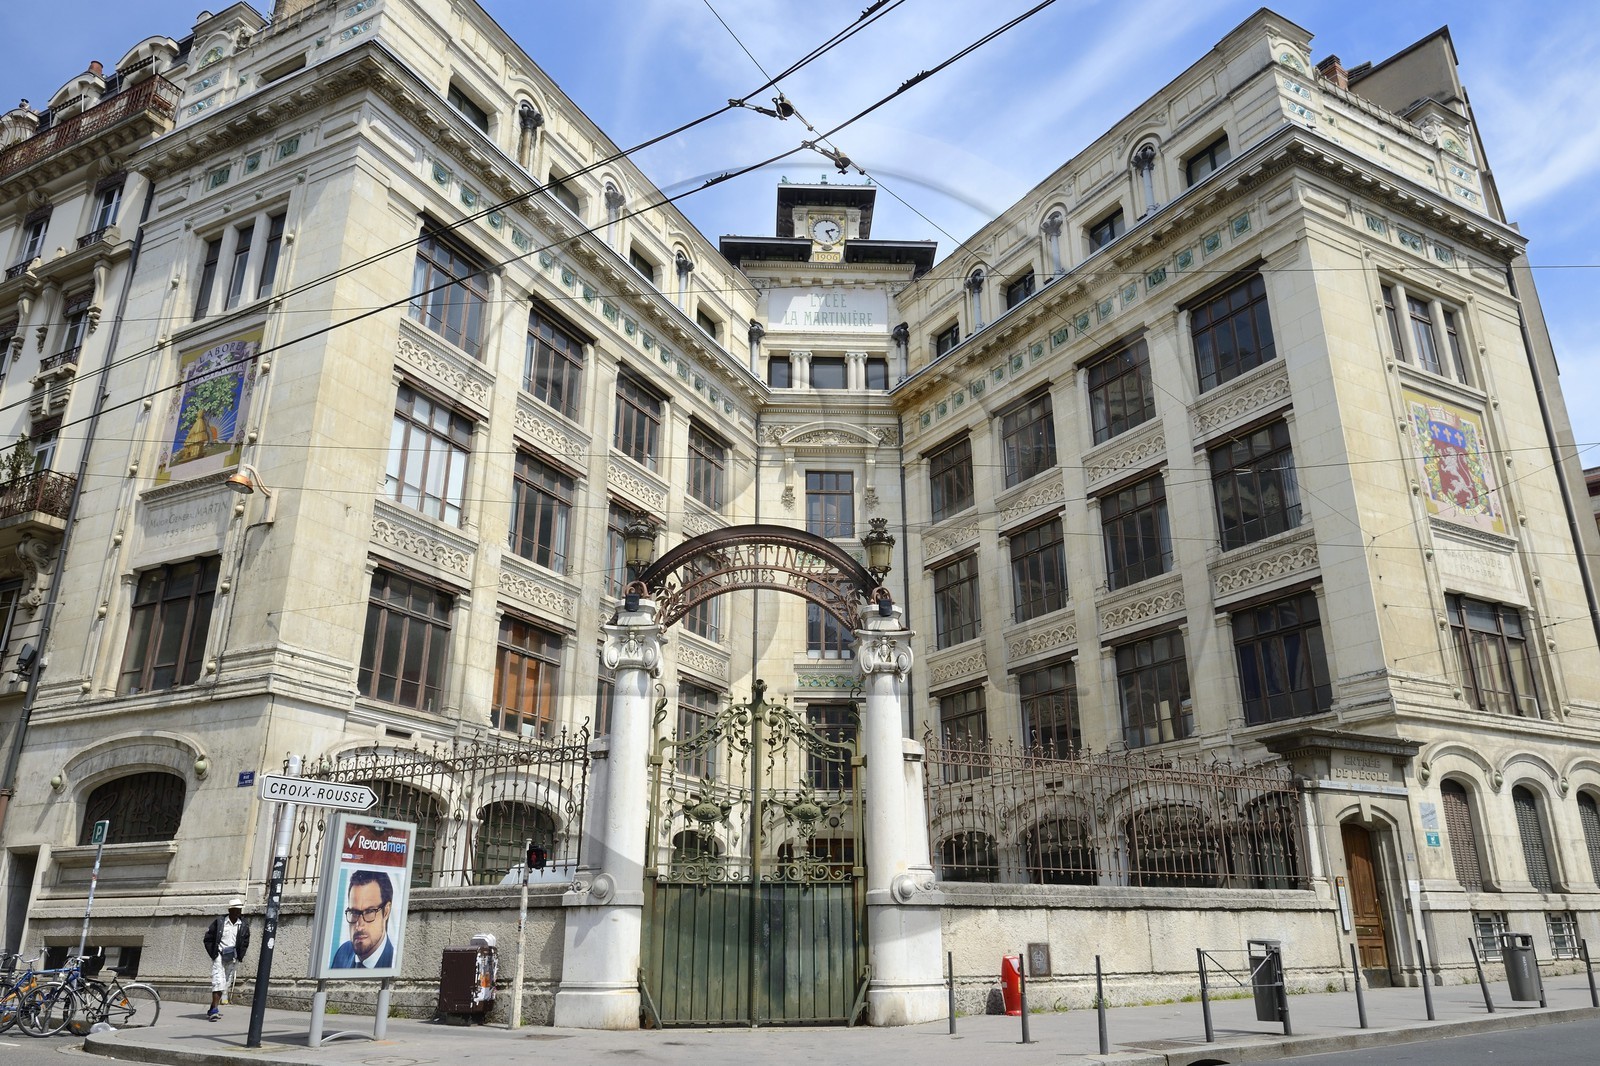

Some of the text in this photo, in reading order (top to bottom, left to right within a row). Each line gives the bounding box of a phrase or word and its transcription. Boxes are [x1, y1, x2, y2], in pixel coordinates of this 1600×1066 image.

[816, 253, 839, 261] 1906
[810, 291, 848, 308] LYCÉE
[783, 310, 874, 327] LA MARTINIÈRE
[199, 341, 244, 364] LABORE
[195, 500, 229, 518] MARTIN
[724, 568, 776, 587] JEUNES
[1343, 754, 1381, 769] ENTRÉE
[1336, 768, 1349, 779] DE
[270, 782, 365, 804] CROIX-ROUSSE
[95, 825, 103, 840] P
